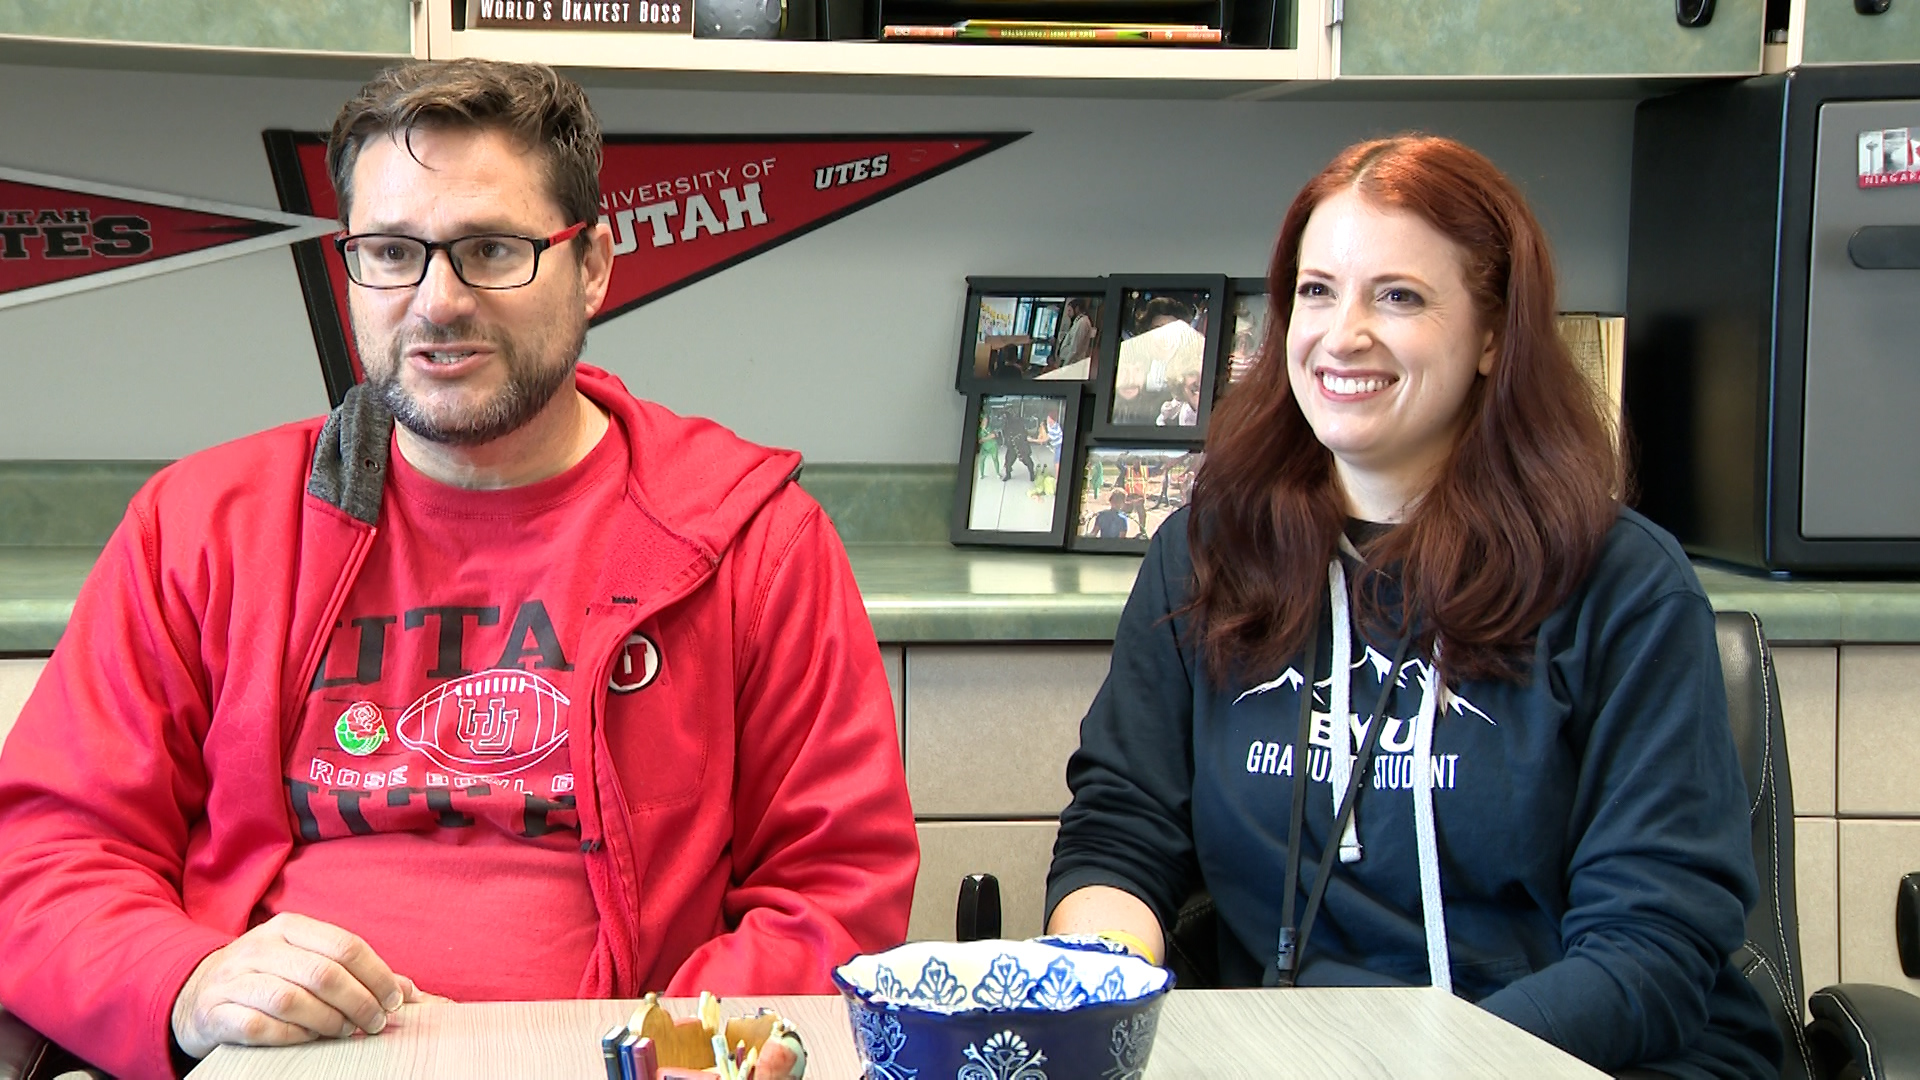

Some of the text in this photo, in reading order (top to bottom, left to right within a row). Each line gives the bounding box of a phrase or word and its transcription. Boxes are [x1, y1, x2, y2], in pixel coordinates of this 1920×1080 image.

[561, 0, 630, 23] OKAYEST
[639, 1, 681, 24] BOSS
[599, 157, 777, 210] NIVERSITY OF
[815, 153, 892, 190] UTES
[1865, 170, 1920, 184] NIAGAR
[0, 209, 91, 225] TAH
[598, 181, 769, 257] UTAH
[0, 215, 153, 259] TES
[311, 599, 575, 692] UTA
[309, 757, 409, 789] ROSE
[1373, 754, 1460, 790] STUDNT
